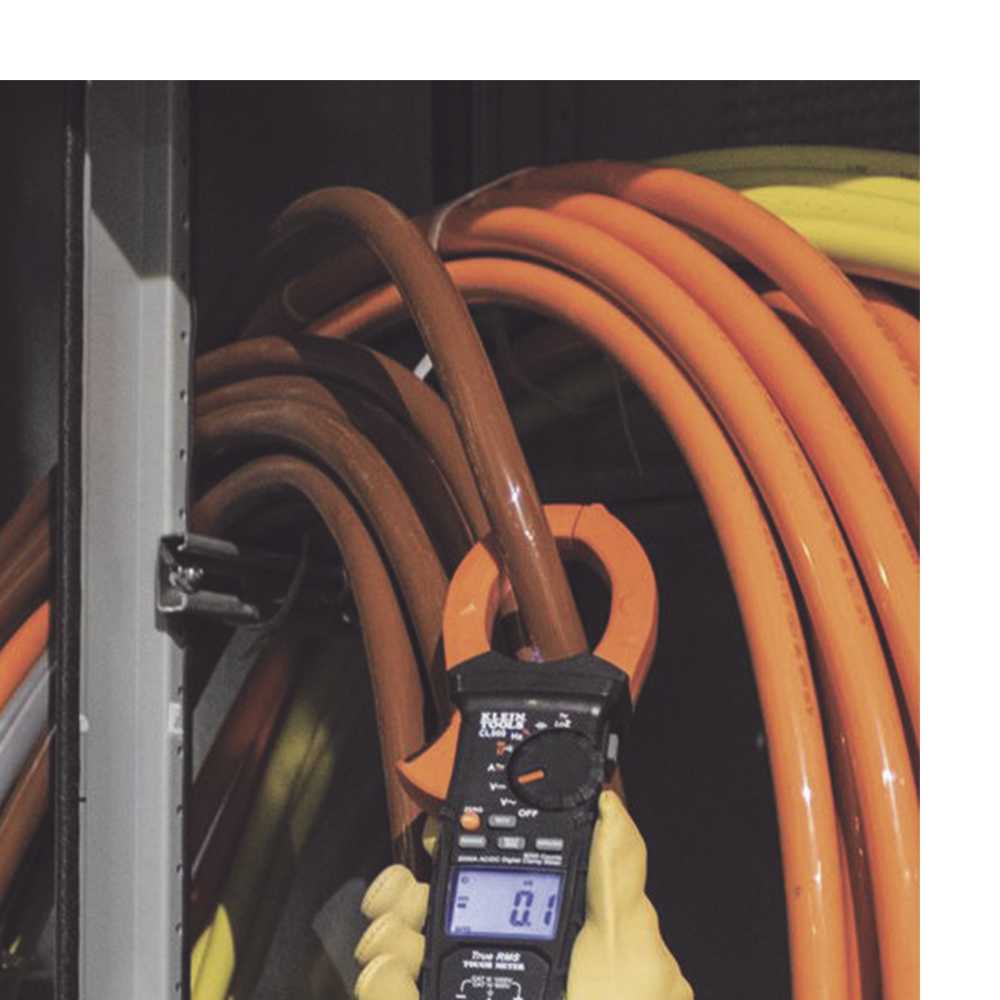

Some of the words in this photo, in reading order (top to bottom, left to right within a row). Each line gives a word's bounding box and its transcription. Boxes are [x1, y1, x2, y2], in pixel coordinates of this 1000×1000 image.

[481, 712, 526, 722] KLEIN
[518, 808, 538, 818] OFF
[472, 950, 494, 960] True
[495, 951, 521, 962] RMS
